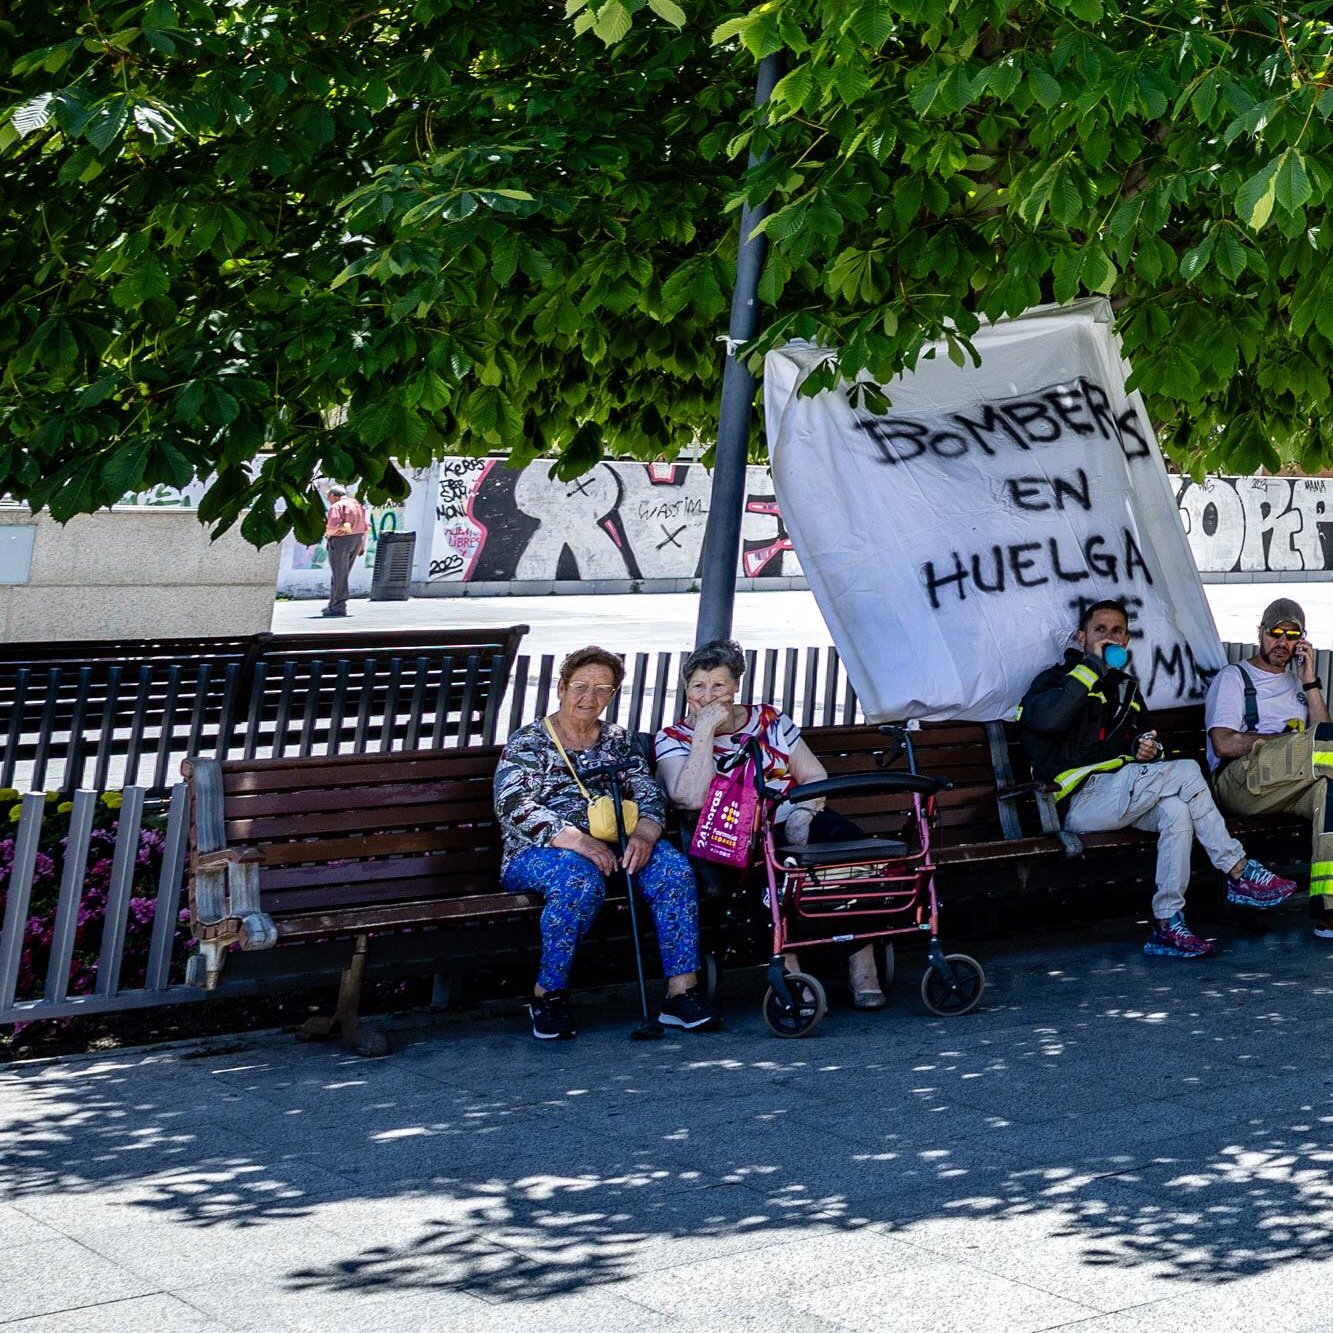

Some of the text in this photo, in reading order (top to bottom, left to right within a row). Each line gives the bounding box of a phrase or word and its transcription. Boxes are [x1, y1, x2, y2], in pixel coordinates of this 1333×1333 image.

[1005, 467, 1092, 511] EN
[428, 554, 465, 577] 2023
[922, 527, 1154, 609] HUELGA
[702, 789, 723, 831] horas
